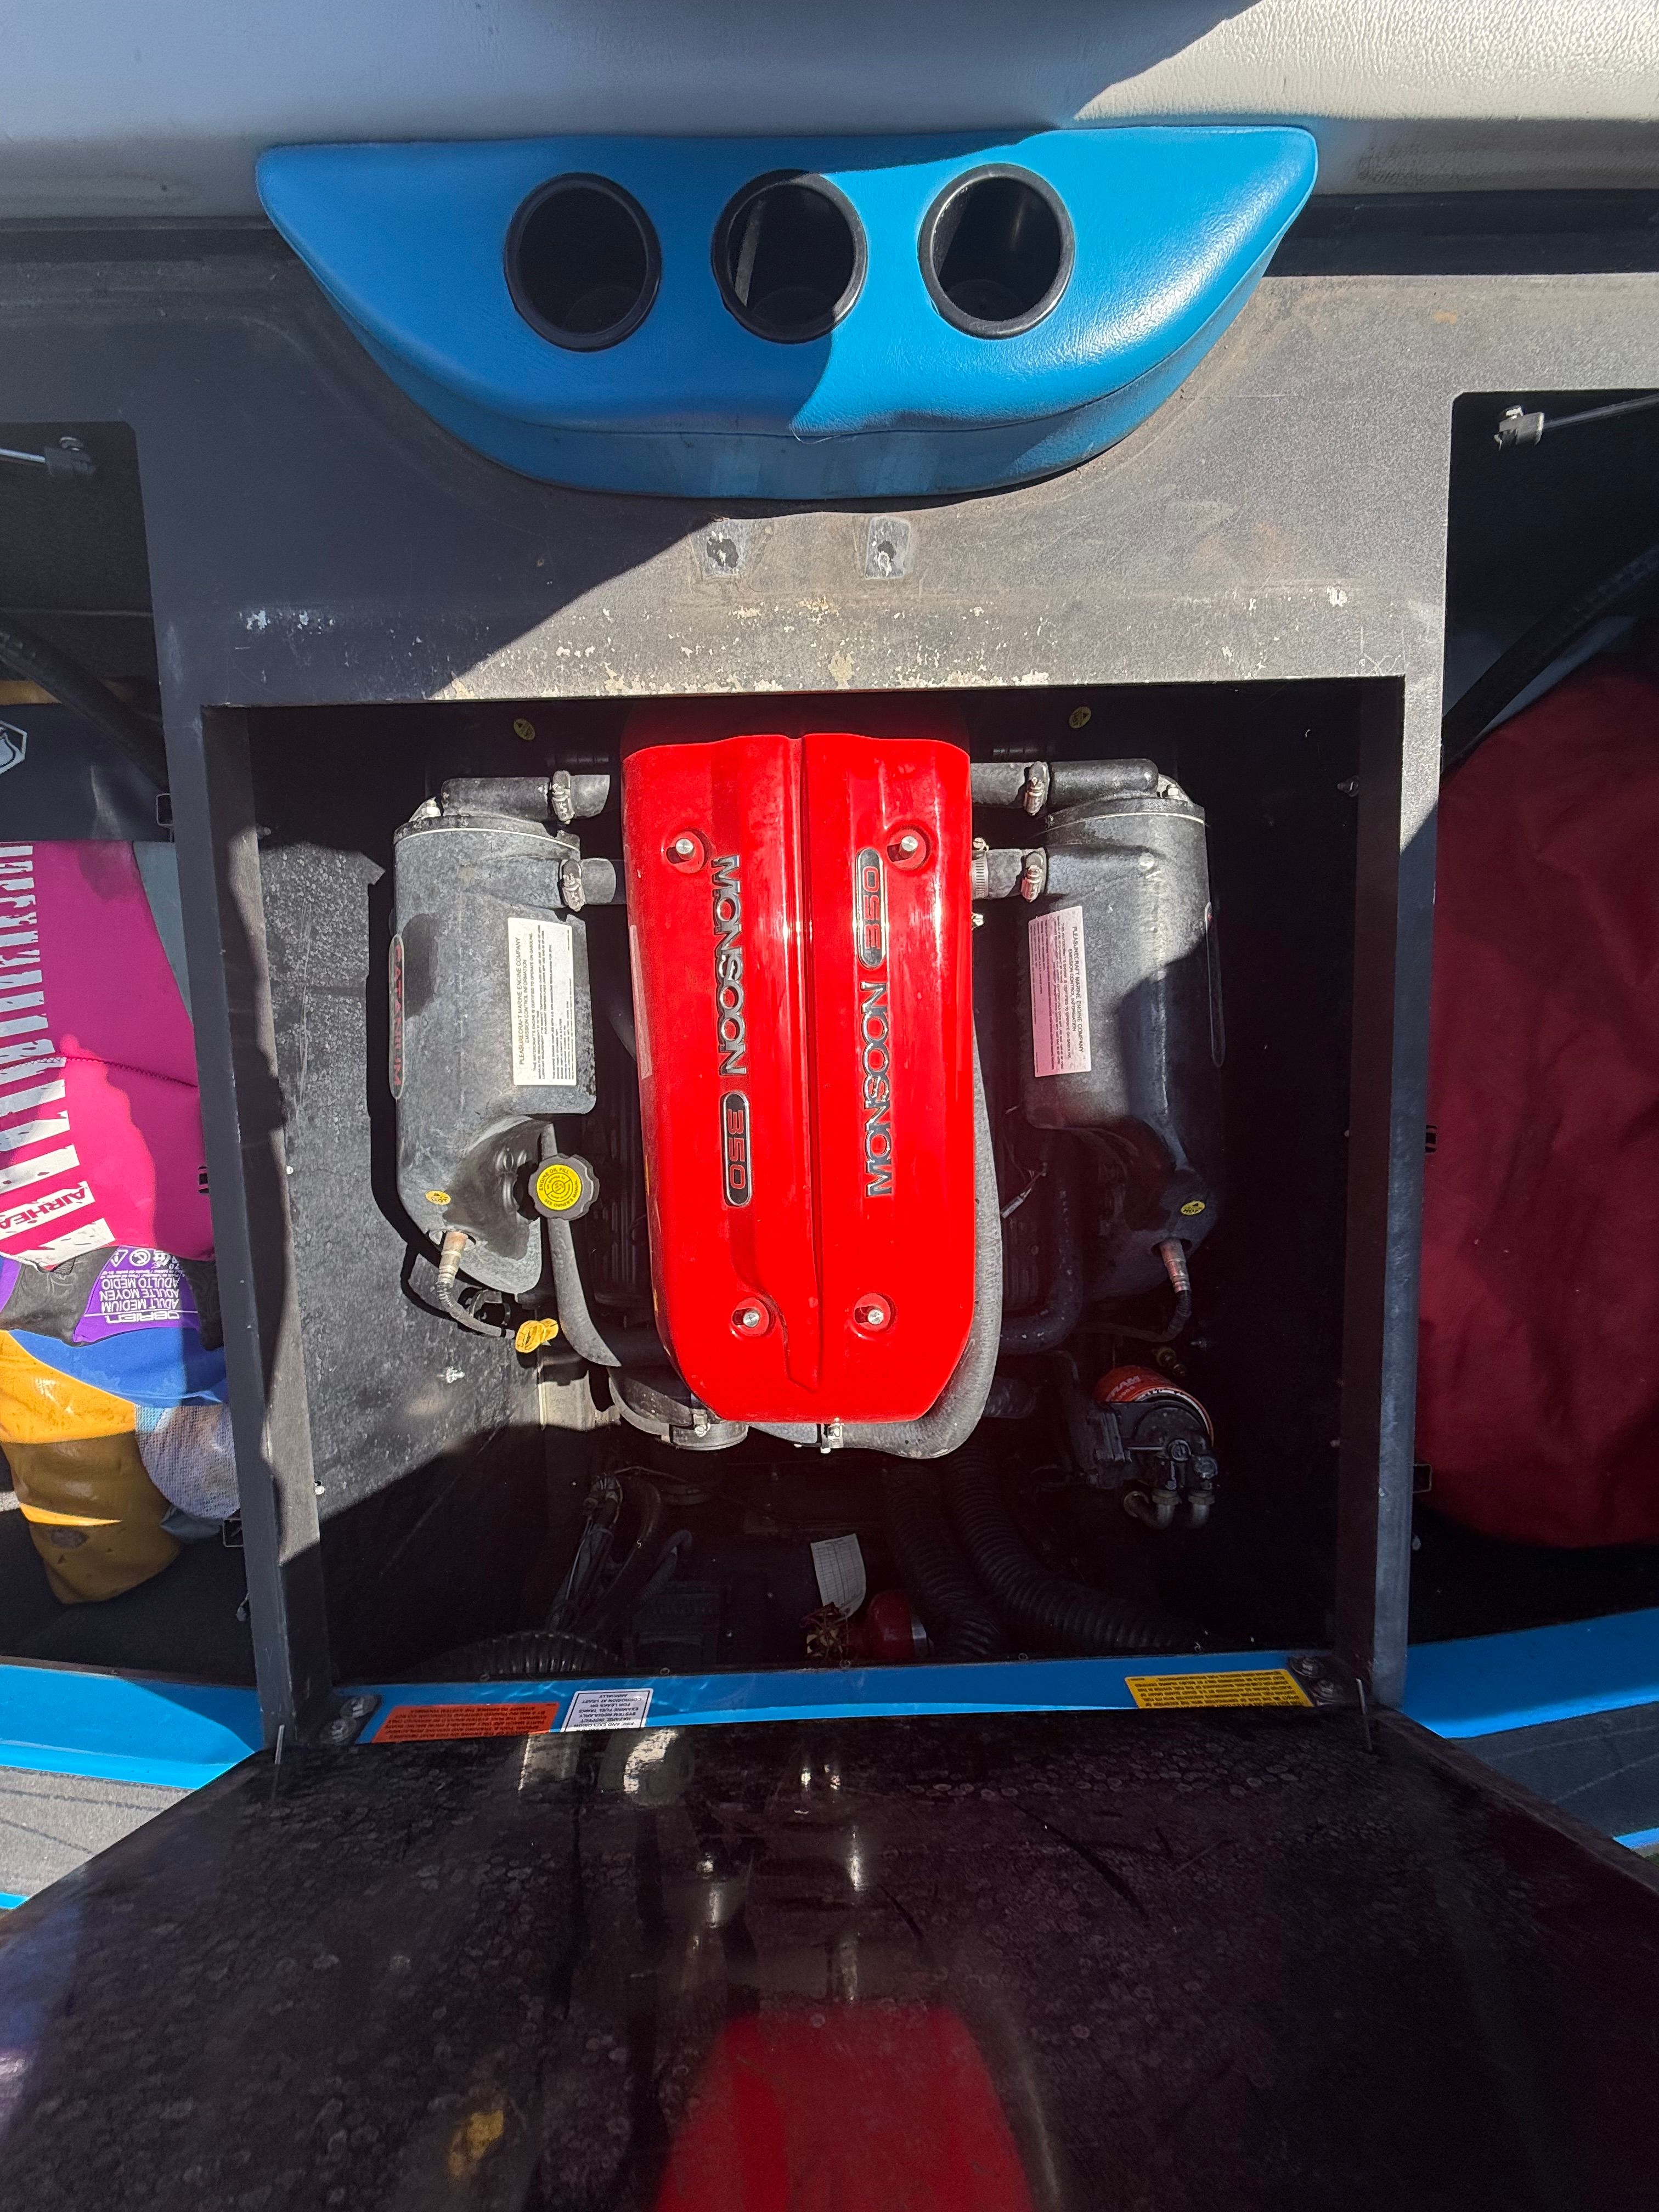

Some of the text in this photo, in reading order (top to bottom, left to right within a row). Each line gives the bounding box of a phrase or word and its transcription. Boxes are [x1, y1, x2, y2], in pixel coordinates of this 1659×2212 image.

[711, 854, 747, 1189] MONSOON 350
[860, 866, 892, 1197] MONSOON 350
[539, 1172, 549, 1190] ENGINE
[101, 1277, 180, 1289] ADULTO MEDIO
[99, 1288, 179, 1301] ADULTE MOYEN
[101, 1298, 179, 1312] ADULT MEDIUM
